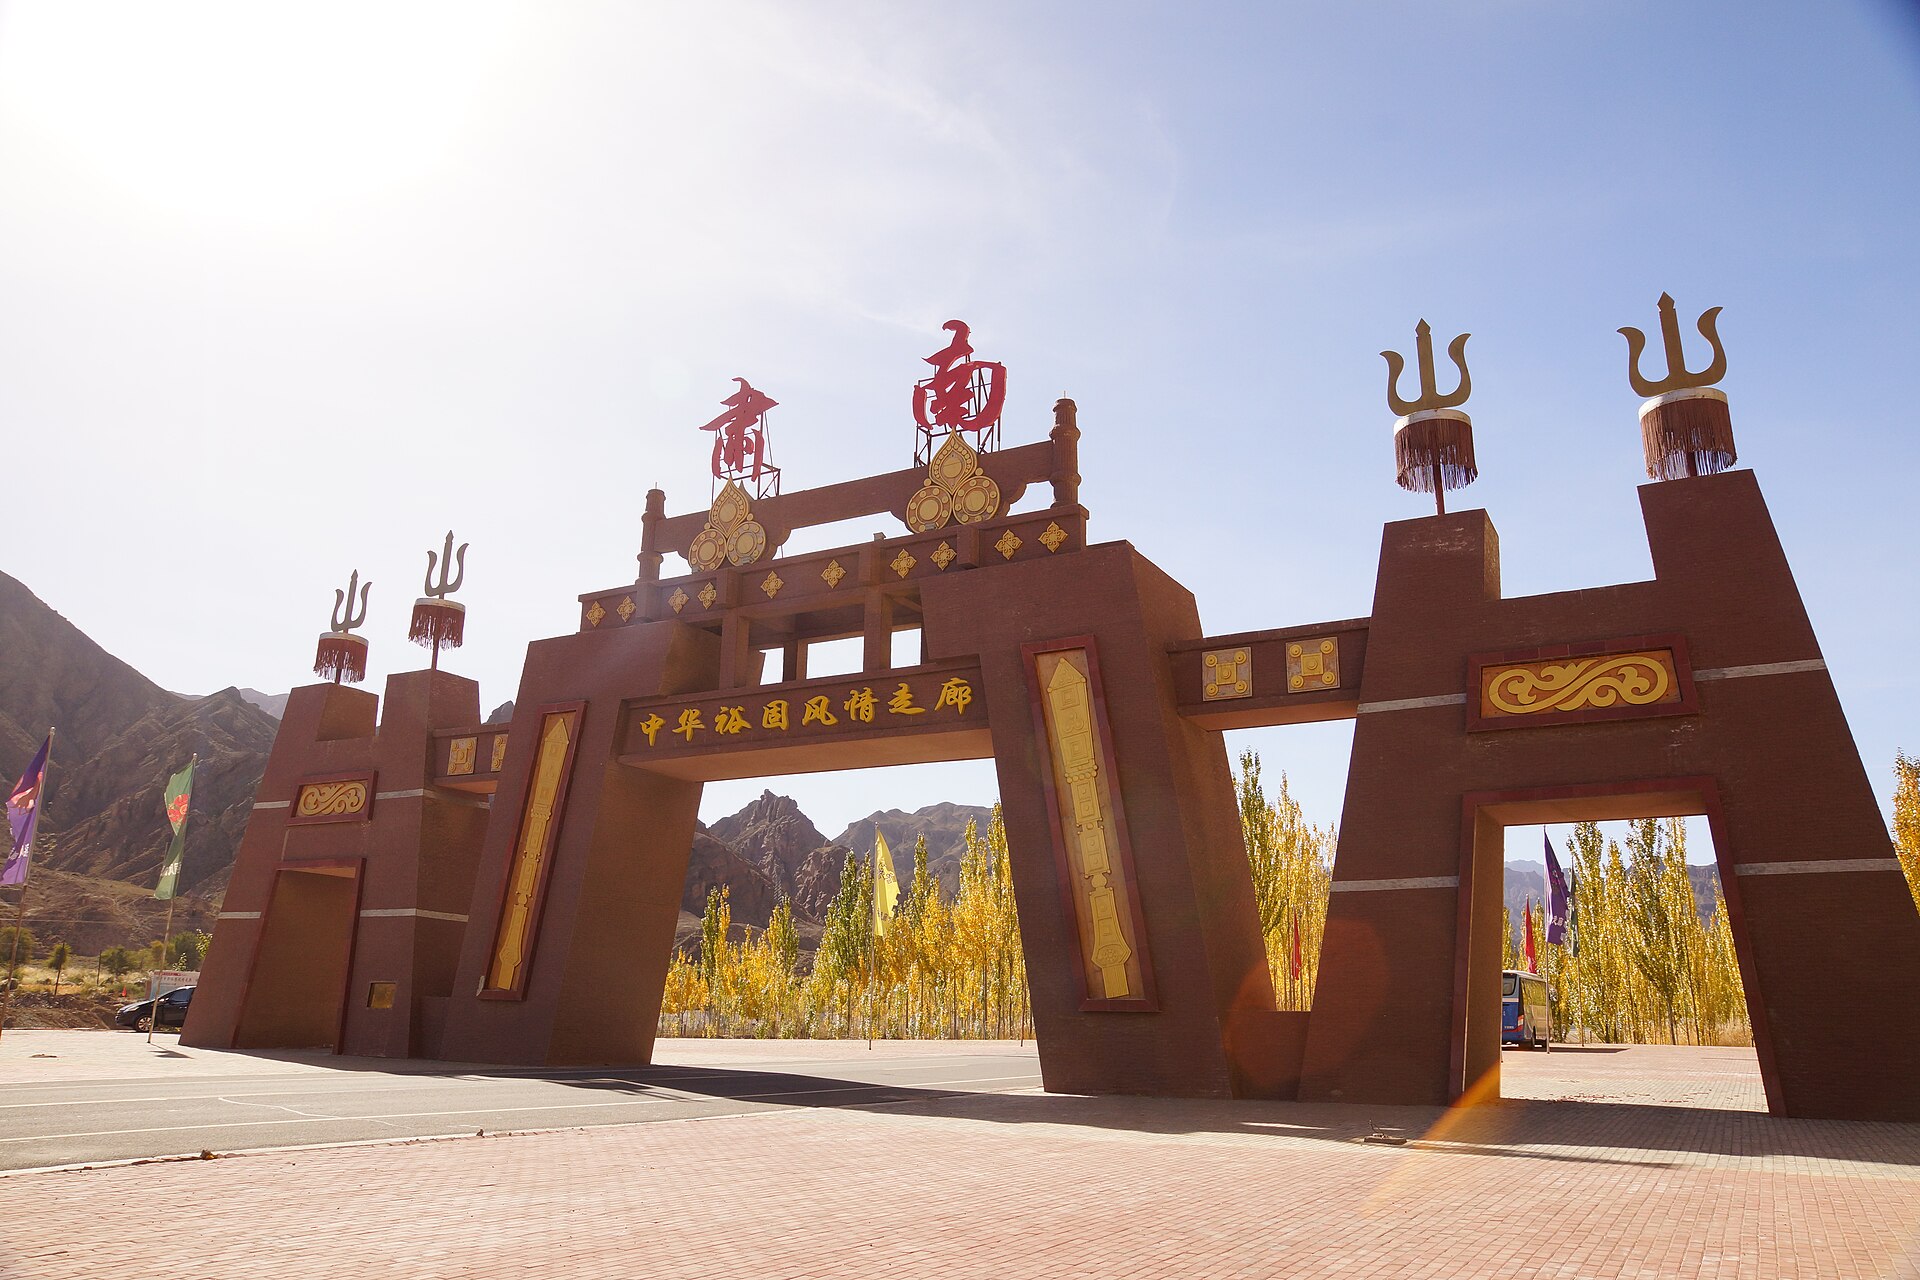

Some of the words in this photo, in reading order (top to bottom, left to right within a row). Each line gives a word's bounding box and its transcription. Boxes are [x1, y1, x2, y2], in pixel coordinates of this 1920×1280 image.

[699, 319, 1007, 482] 肃南
[639, 677, 974, 747] 中华裕固风情走廊
